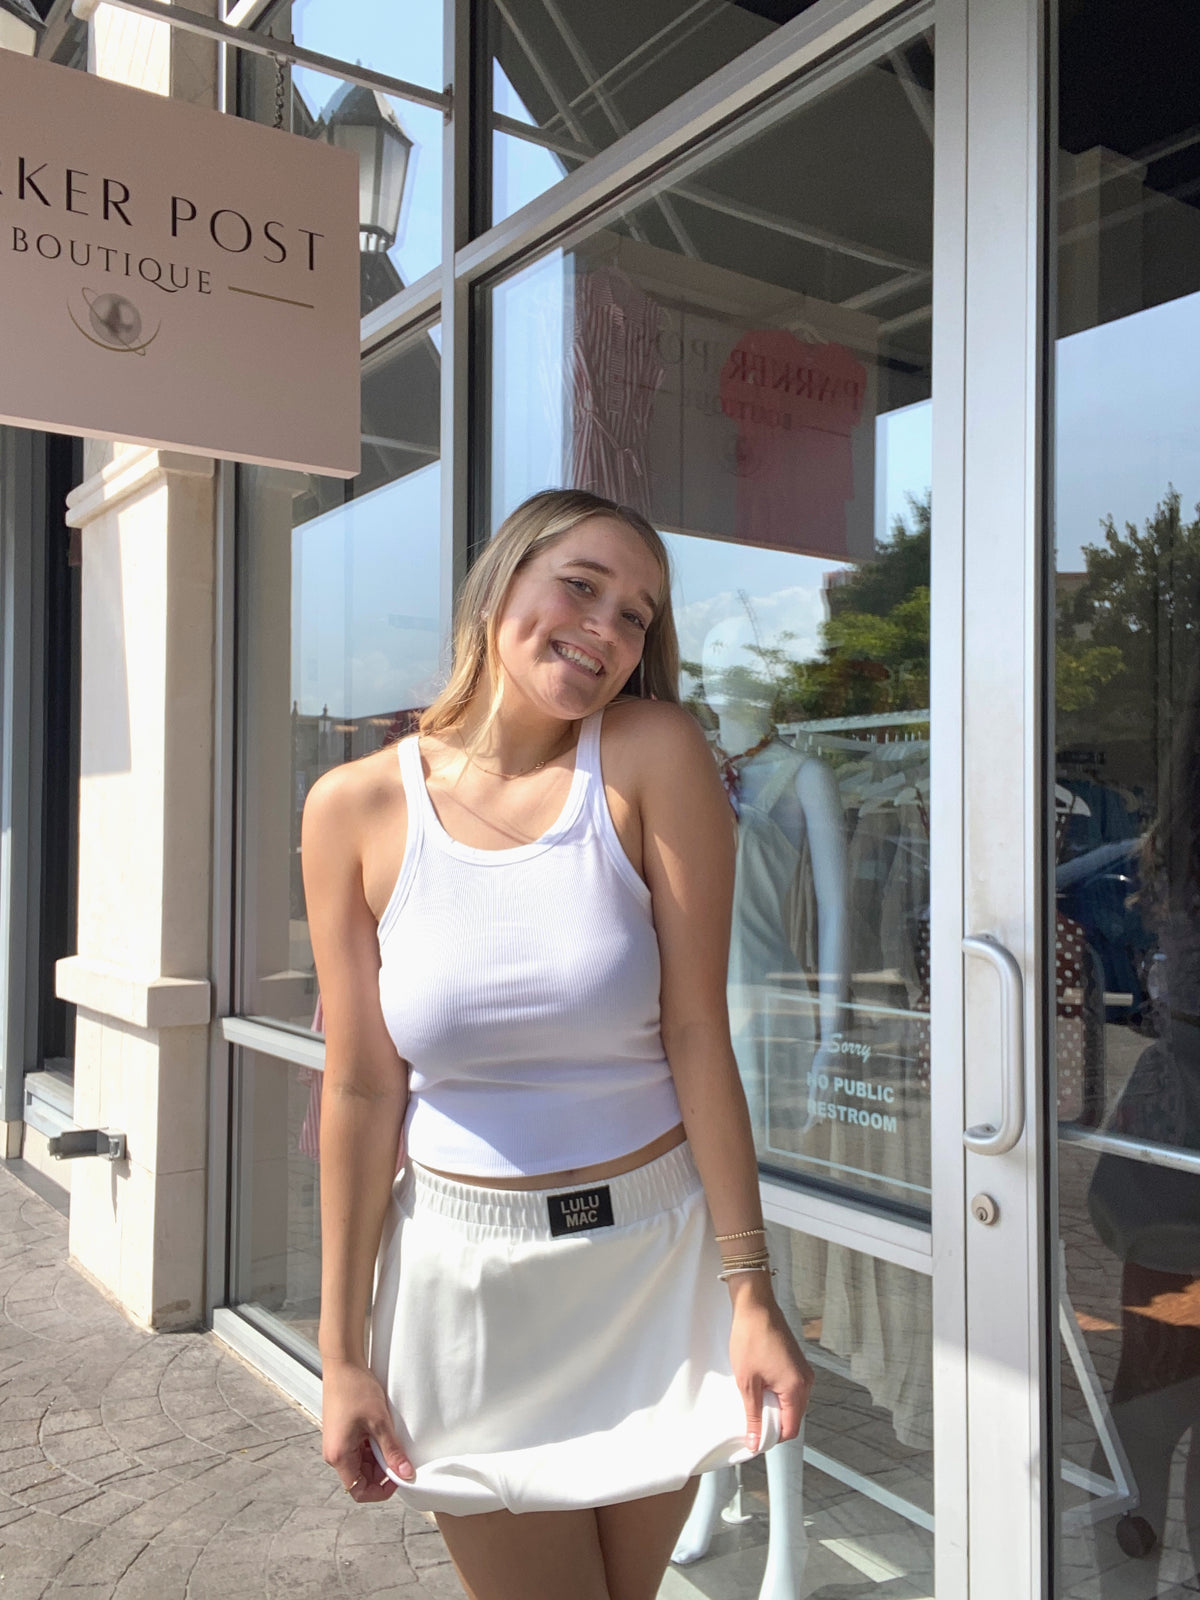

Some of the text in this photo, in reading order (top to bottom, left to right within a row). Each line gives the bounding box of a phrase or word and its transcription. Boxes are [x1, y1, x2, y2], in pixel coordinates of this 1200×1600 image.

[0, 156, 325, 271] KER POST
[11, 226, 212, 294] BOUTIQUE
[827, 1033, 872, 1063] Sorry
[806, 1072, 895, 1103] NO PUBLIC
[560, 1195, 600, 1213] LULU
[566, 1210, 598, 1227] MAC
